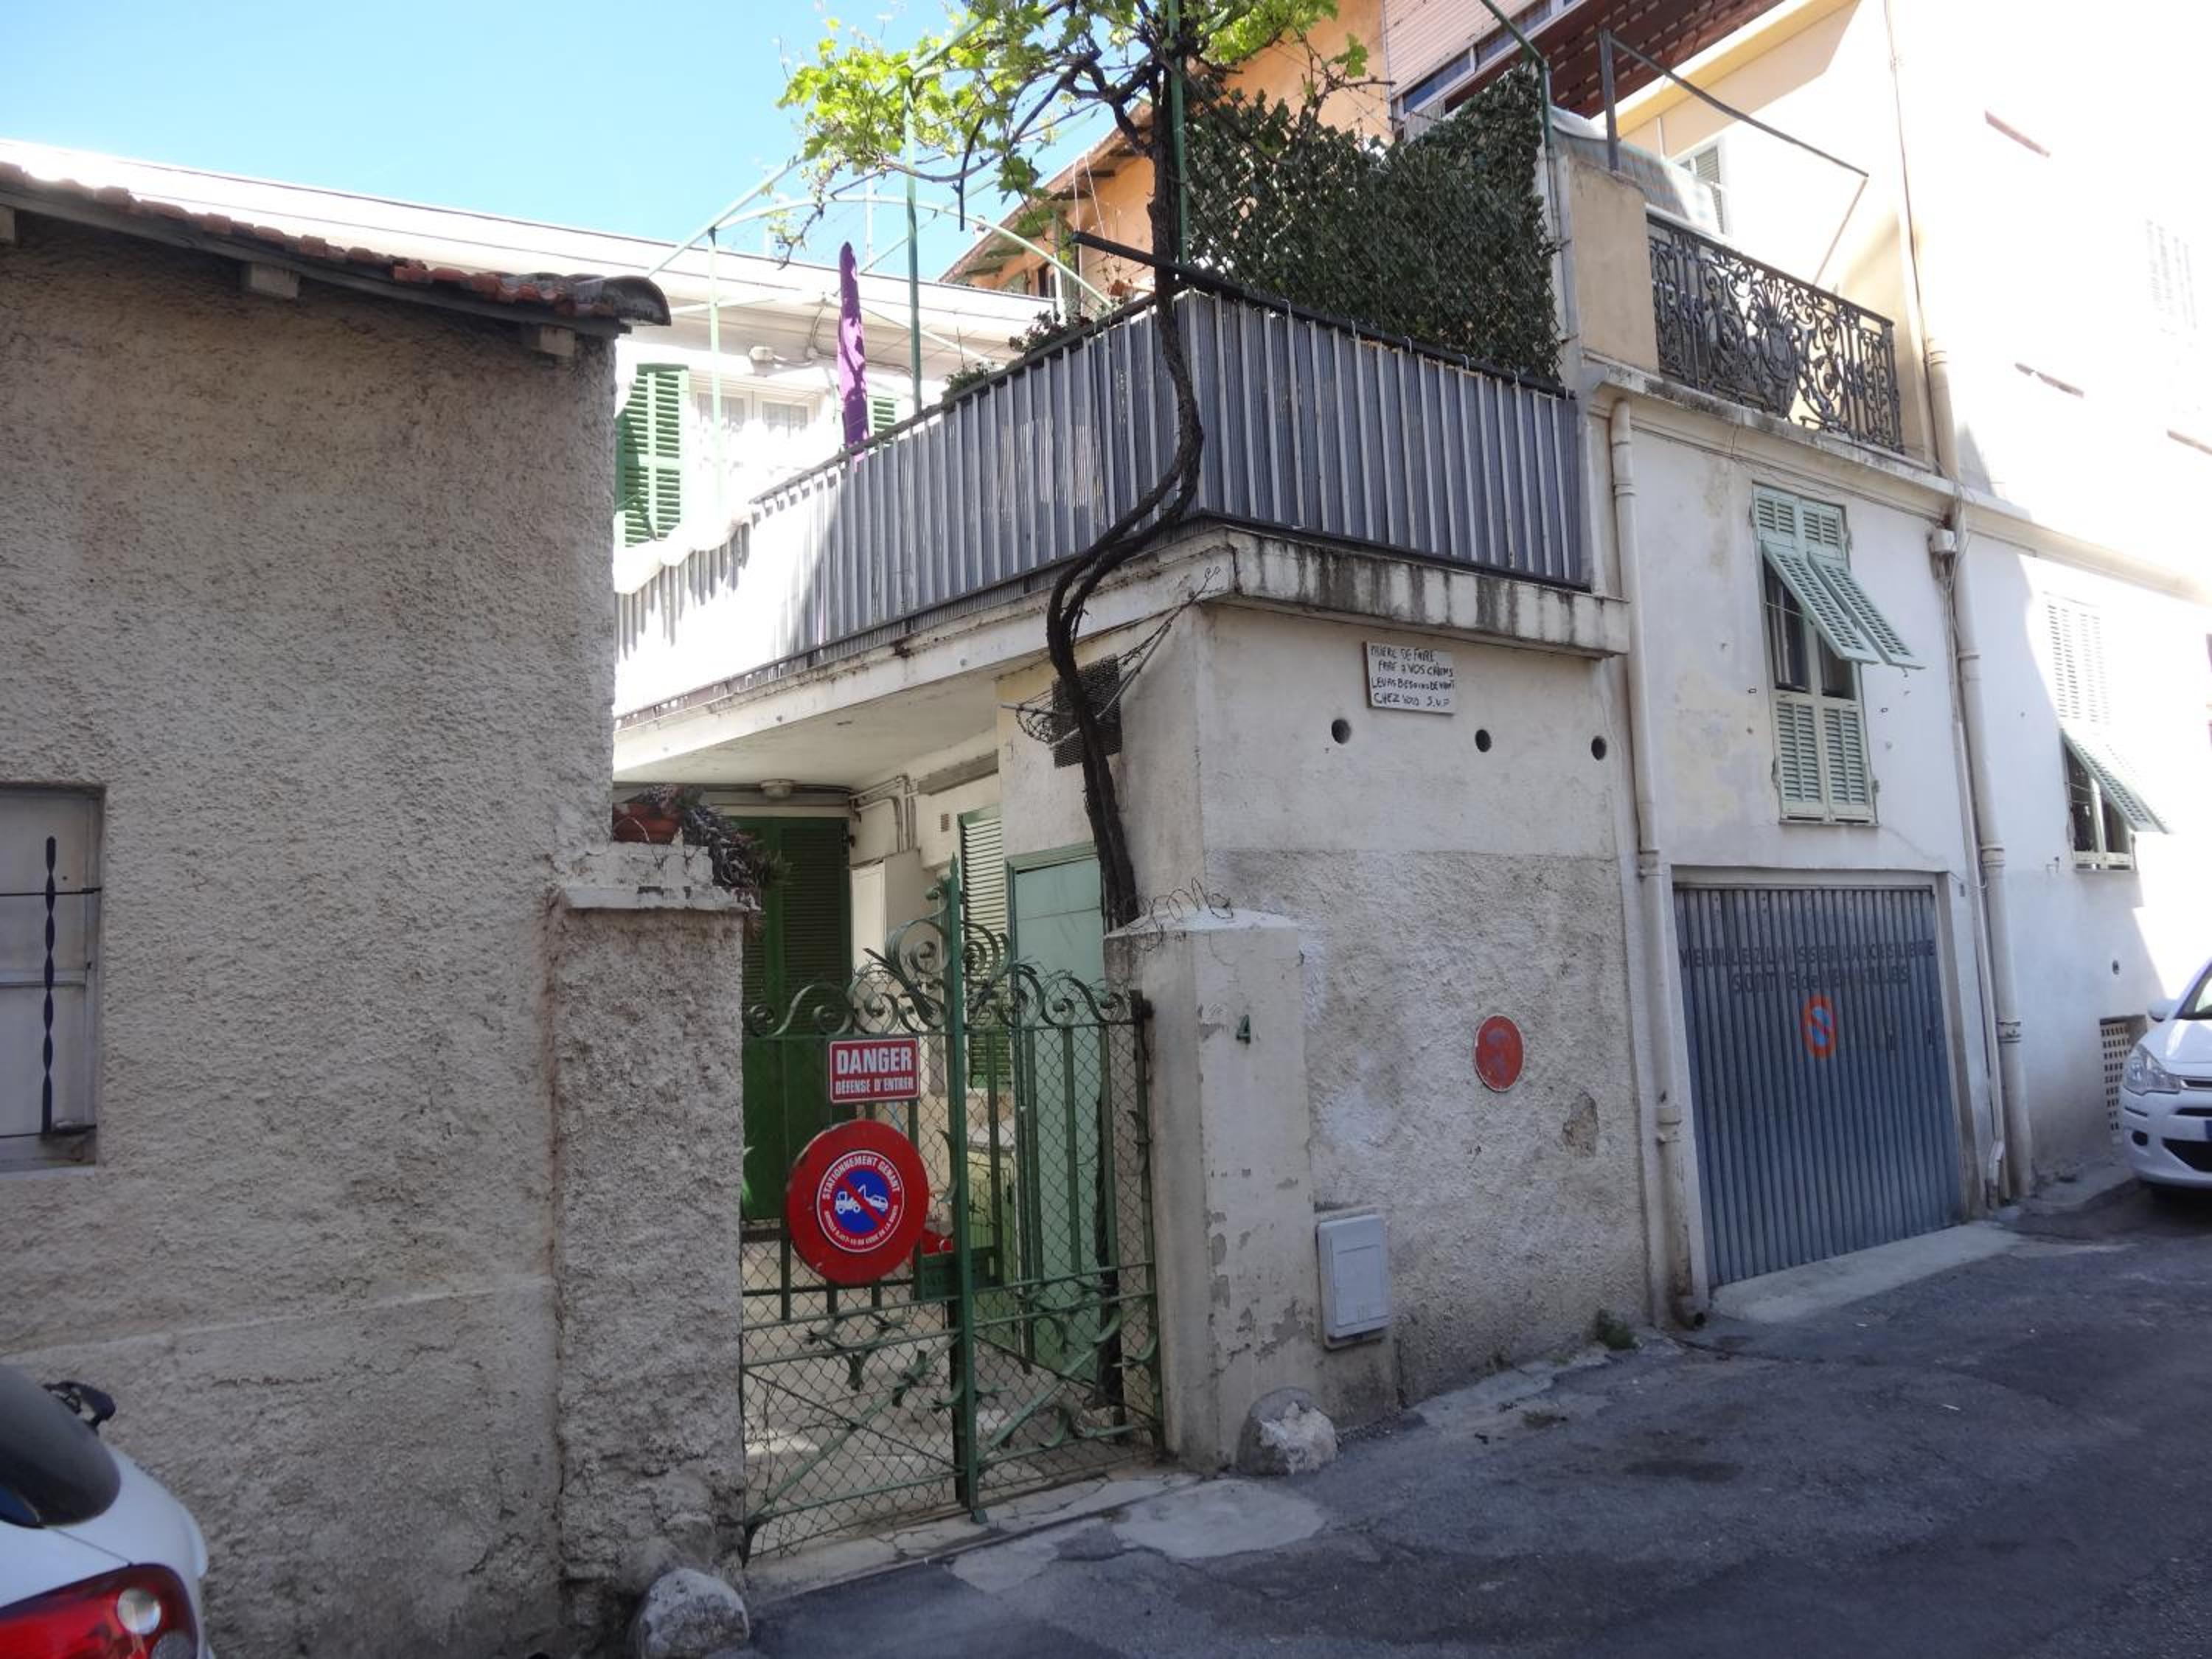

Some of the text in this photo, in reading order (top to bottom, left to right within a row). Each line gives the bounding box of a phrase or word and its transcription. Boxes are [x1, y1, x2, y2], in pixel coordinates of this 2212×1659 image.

[1374, 692, 1400, 704] CHEZ
[1236, 1015, 1251, 1045] 4
[836, 1047, 912, 1074] DANGER
[821, 1155, 878, 1200] STATIONNEMENT
